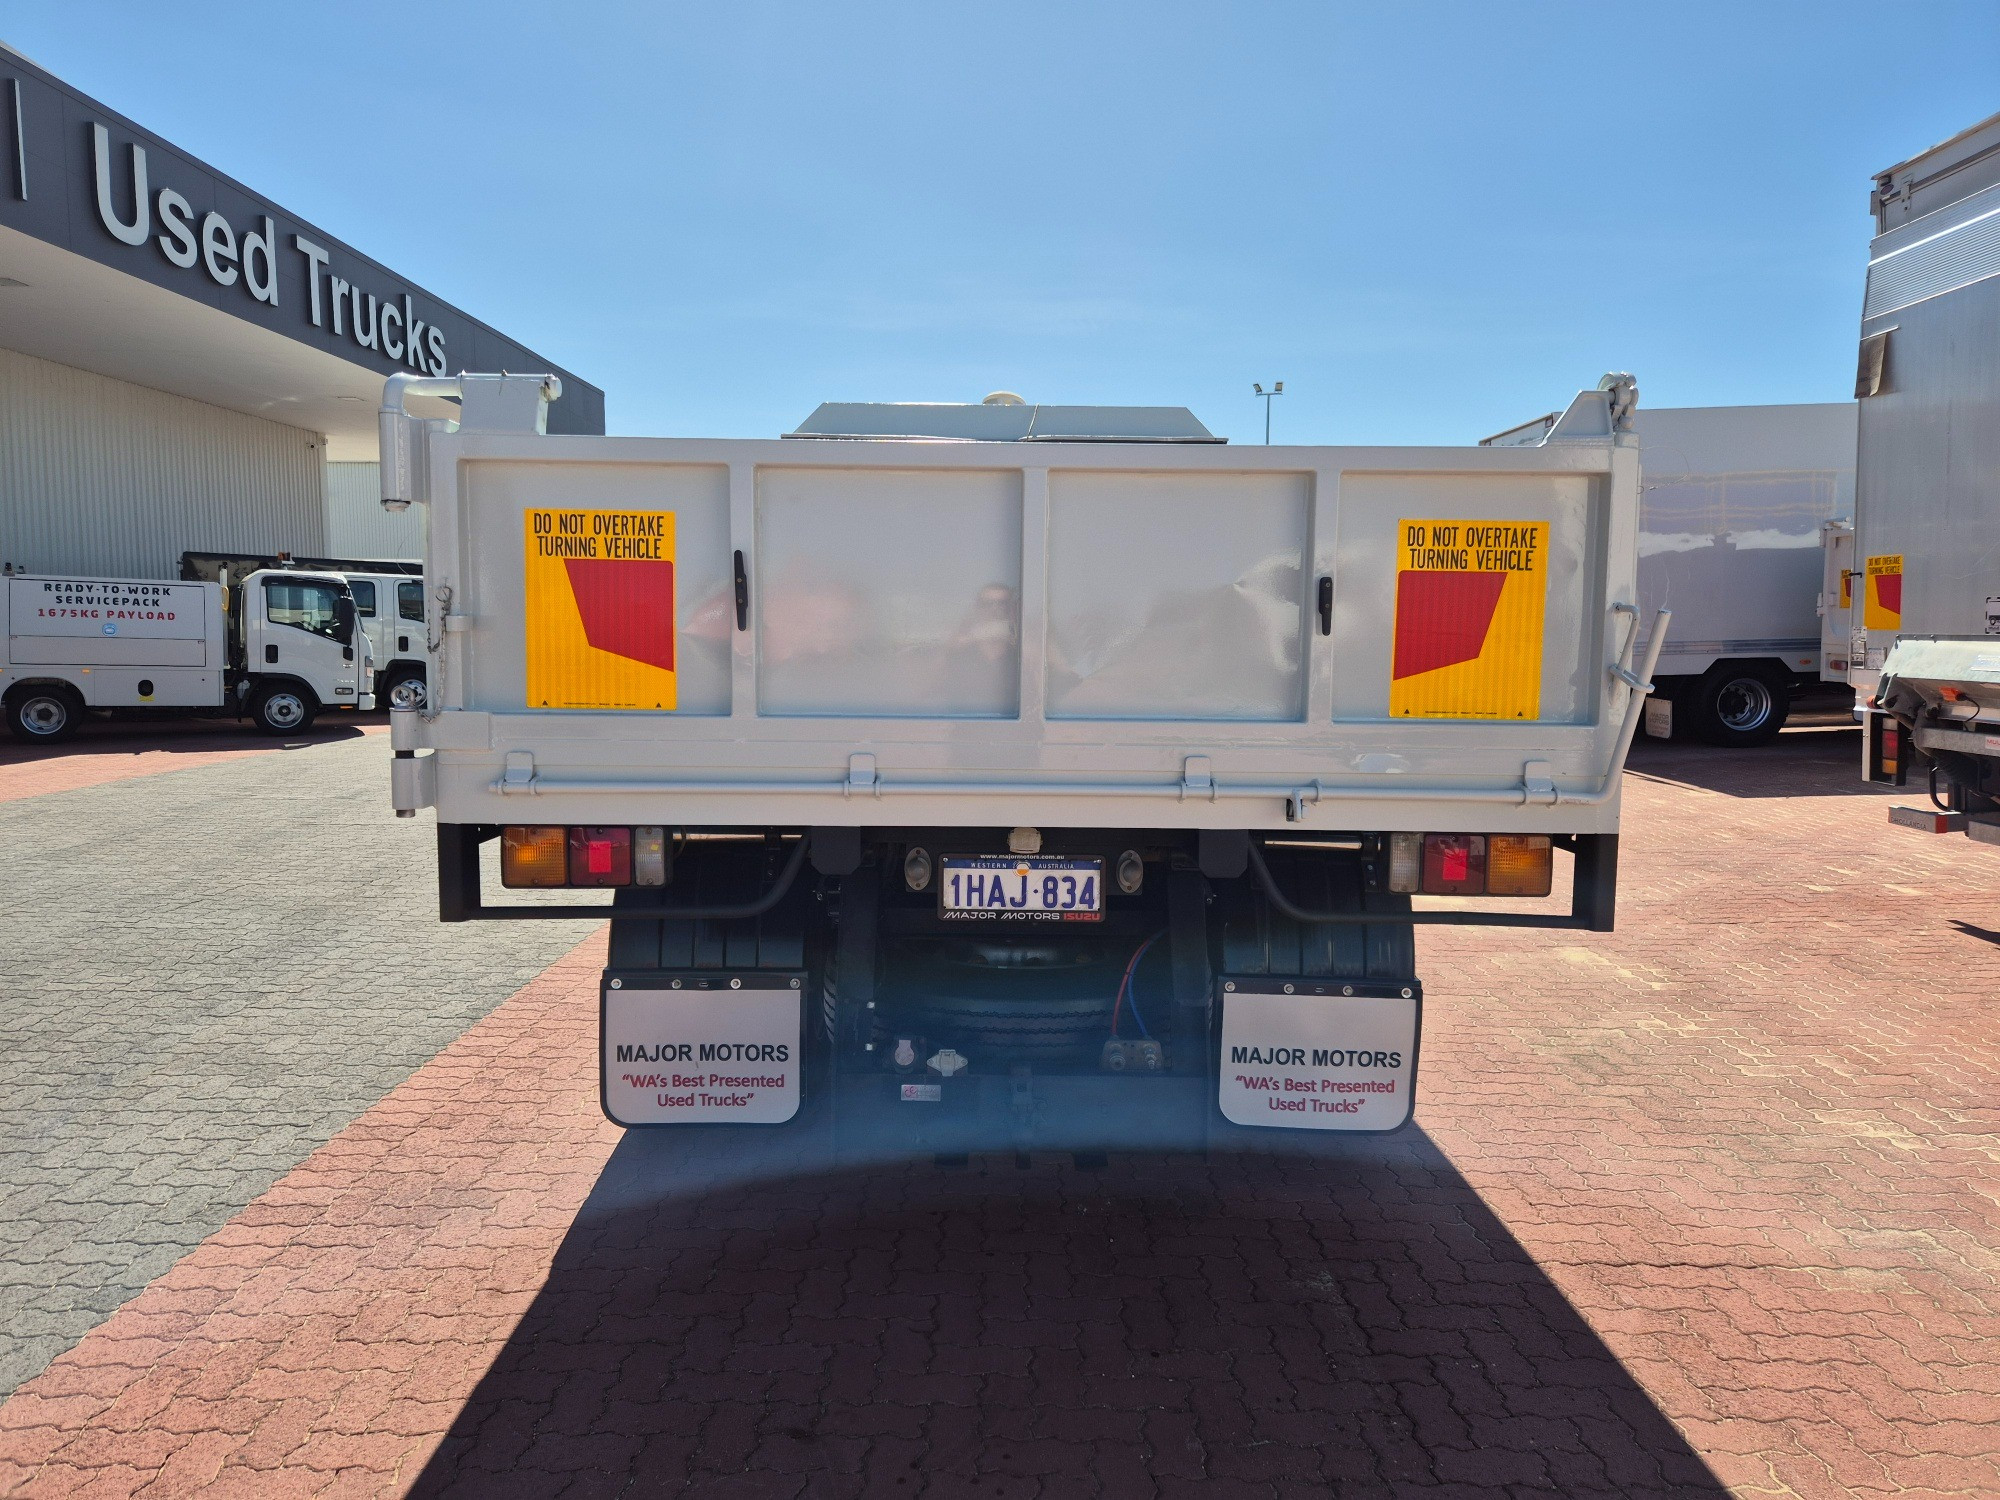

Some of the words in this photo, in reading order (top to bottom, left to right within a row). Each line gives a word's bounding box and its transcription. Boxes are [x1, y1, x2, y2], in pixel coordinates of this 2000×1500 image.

[88, 121, 279, 307] Used
[291, 233, 447, 378] Trucks
[534, 512, 552, 534] DO
[559, 514, 586, 535] NOT
[593, 514, 665, 537] OVERTAKE
[1407, 526, 1425, 547] DO
[1432, 526, 1459, 548] NOT
[1466, 527, 1538, 549] OVERTAKE
[537, 536, 597, 558] TURNING
[604, 537, 662, 559] VEHICLE
[1410, 548, 1468, 570] TURNING
[1476, 549, 1534, 571] VEHICLE
[44, 583, 171, 596] READY-TO-WORK
[56, 595, 160, 607] SERVICEPACK
[38, 608, 99, 619] 1675KG
[106, 610, 176, 621] PAYLOAD
[980, 853, 1065, 861] www.majormotors.com.au
[943, 911, 997, 920] MAJOR
[1000, 912, 1060, 920] MOTORS
[1063, 912, 1100, 921] ISUZU
[616, 1043, 693, 1063] MAJOR
[699, 1043, 789, 1063] MOTORS
[1231, 1046, 1306, 1067] MAJOR
[1312, 1048, 1402, 1069] MOTORS
[672, 1074, 705, 1088] Best
[709, 1074, 785, 1088] Presented
[1284, 1077, 1317, 1093] Best
[1321, 1078, 1396, 1094] Presented
[657, 1093, 695, 1107] Used
[1269, 1096, 1306, 1112] Used
